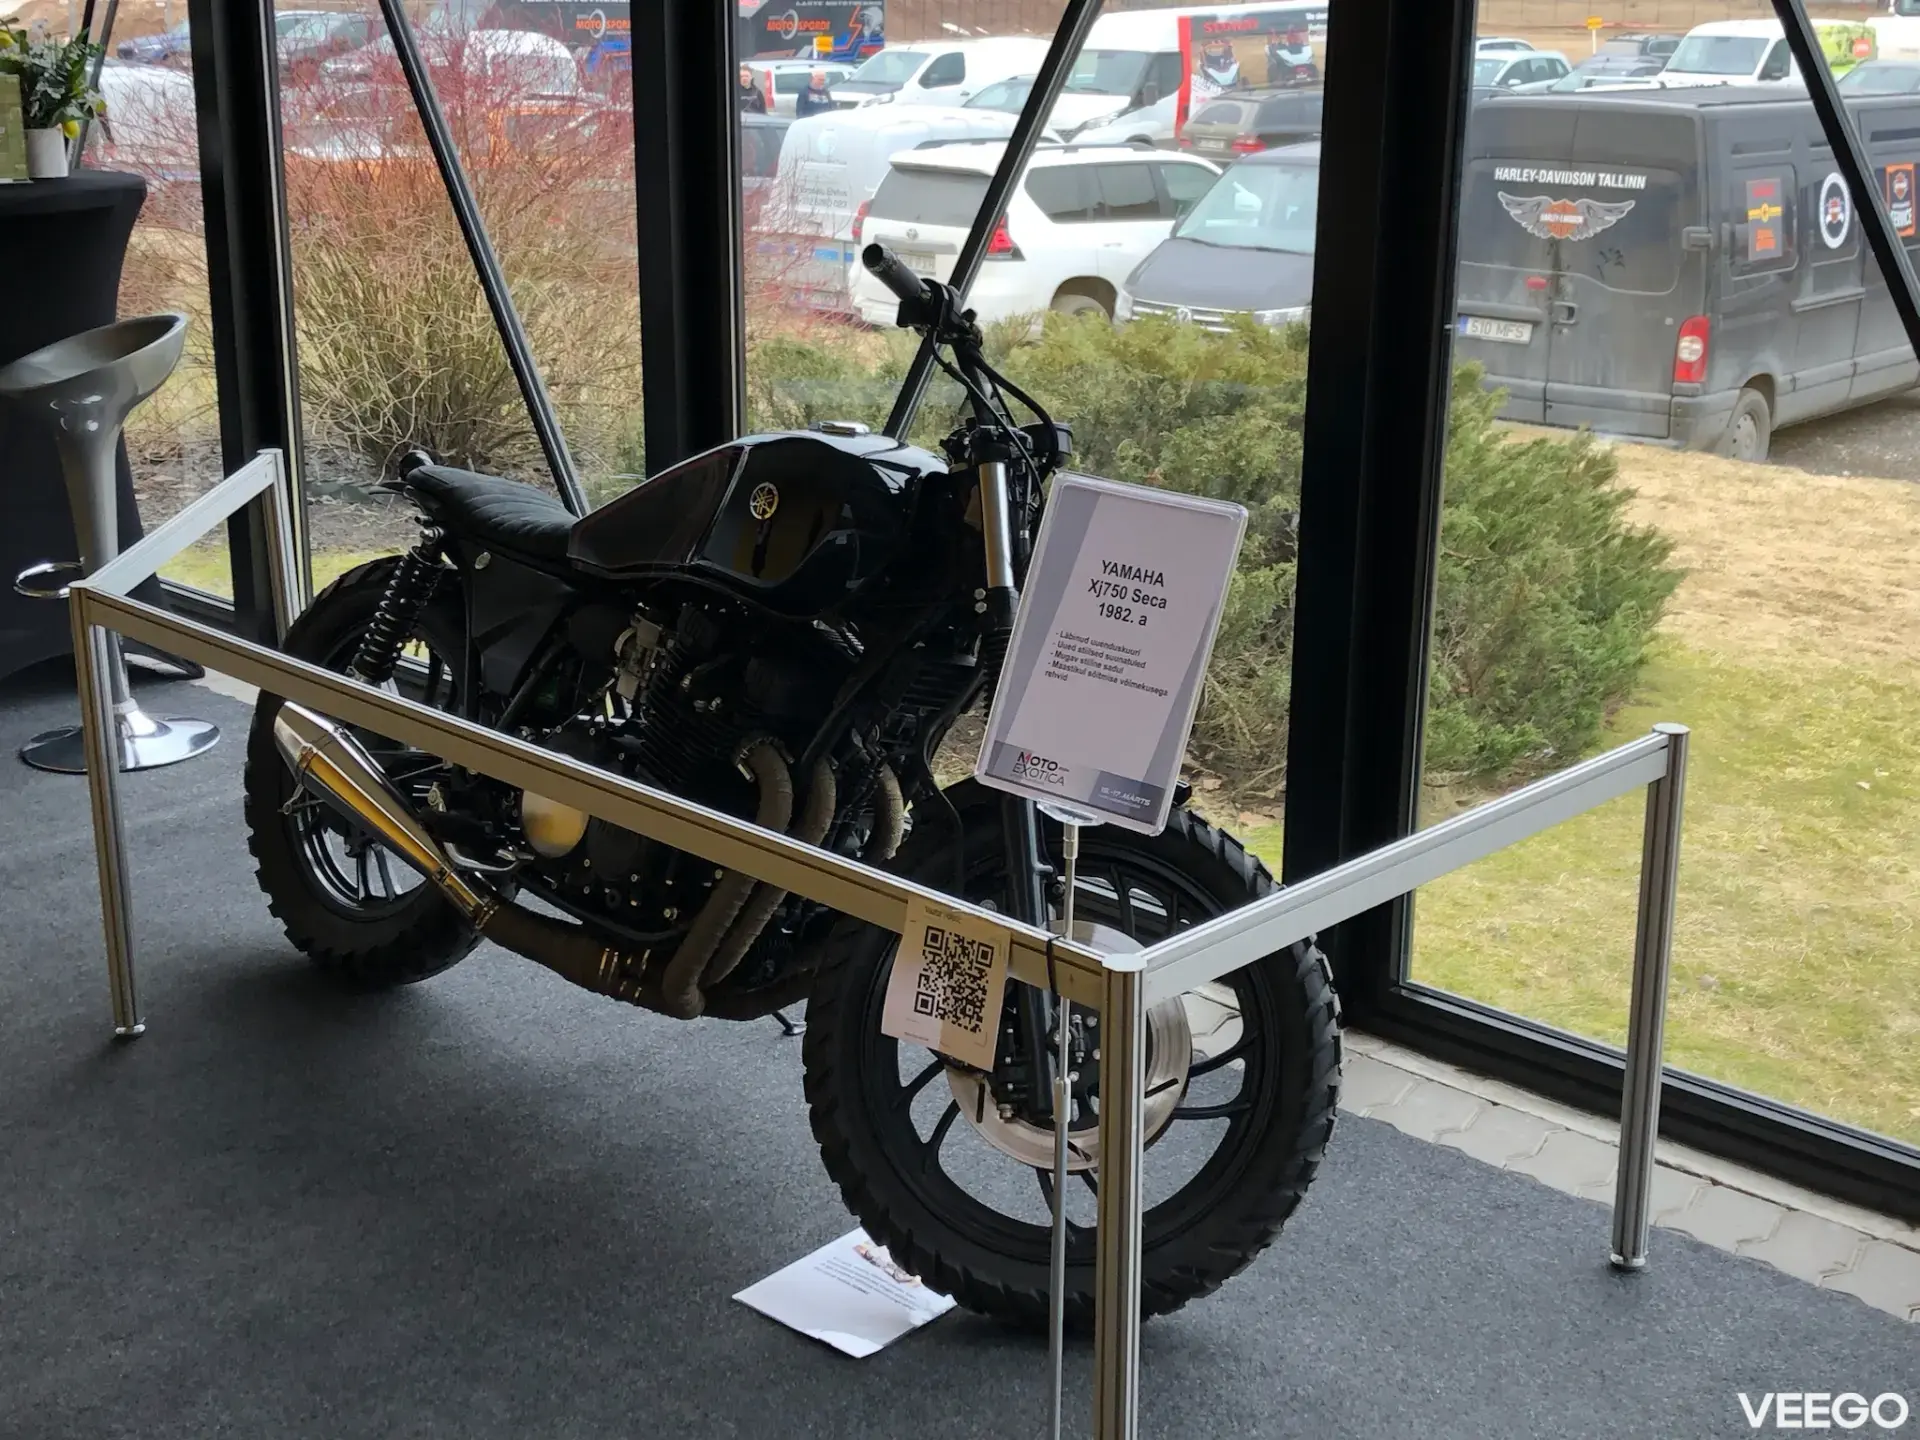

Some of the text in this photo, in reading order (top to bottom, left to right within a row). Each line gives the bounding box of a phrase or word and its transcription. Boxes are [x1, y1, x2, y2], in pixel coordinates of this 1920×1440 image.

[576, 18, 603, 30] MOTO
[766, 20, 794, 31] MOTO
[1494, 166, 1648, 190] HARLEY-DAVIDSON TALLINN
[1102, 560, 1164, 587] YAMAHA
[1088, 578, 1167, 609] Xj750 Seca
[1099, 602, 1148, 626] 1982. a
[1054, 650, 1080, 663] Mugav
[1057, 641, 1077, 652] Uued
[1044, 670, 1069, 682] rehvid
[1017, 752, 1058, 772] MOTO
[1012, 762, 1065, 787] EXOTICA
